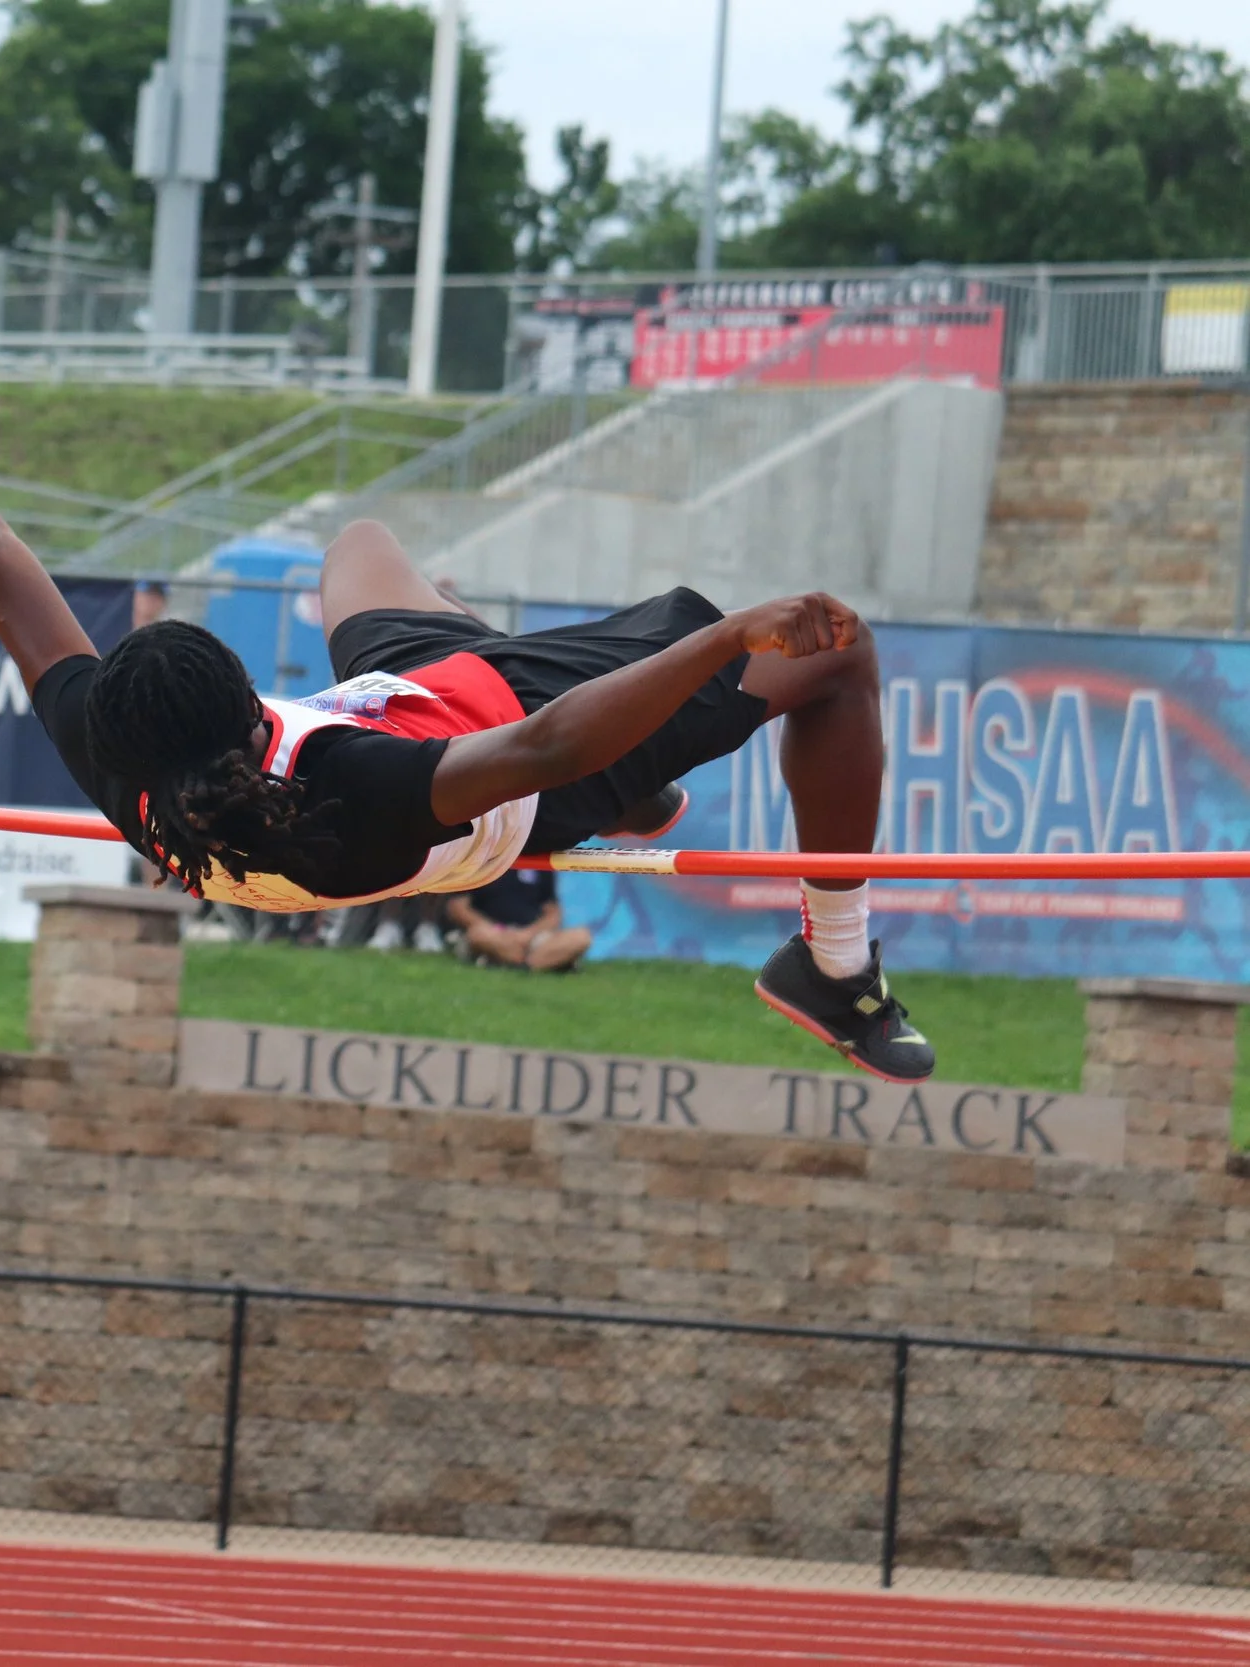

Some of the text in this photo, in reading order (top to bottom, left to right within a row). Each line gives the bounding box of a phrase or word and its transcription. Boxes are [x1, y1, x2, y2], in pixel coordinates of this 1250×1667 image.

[728, 677, 1180, 854] MHSAA
[242, 1029, 1061, 1155] LICKLIDER TRACK
